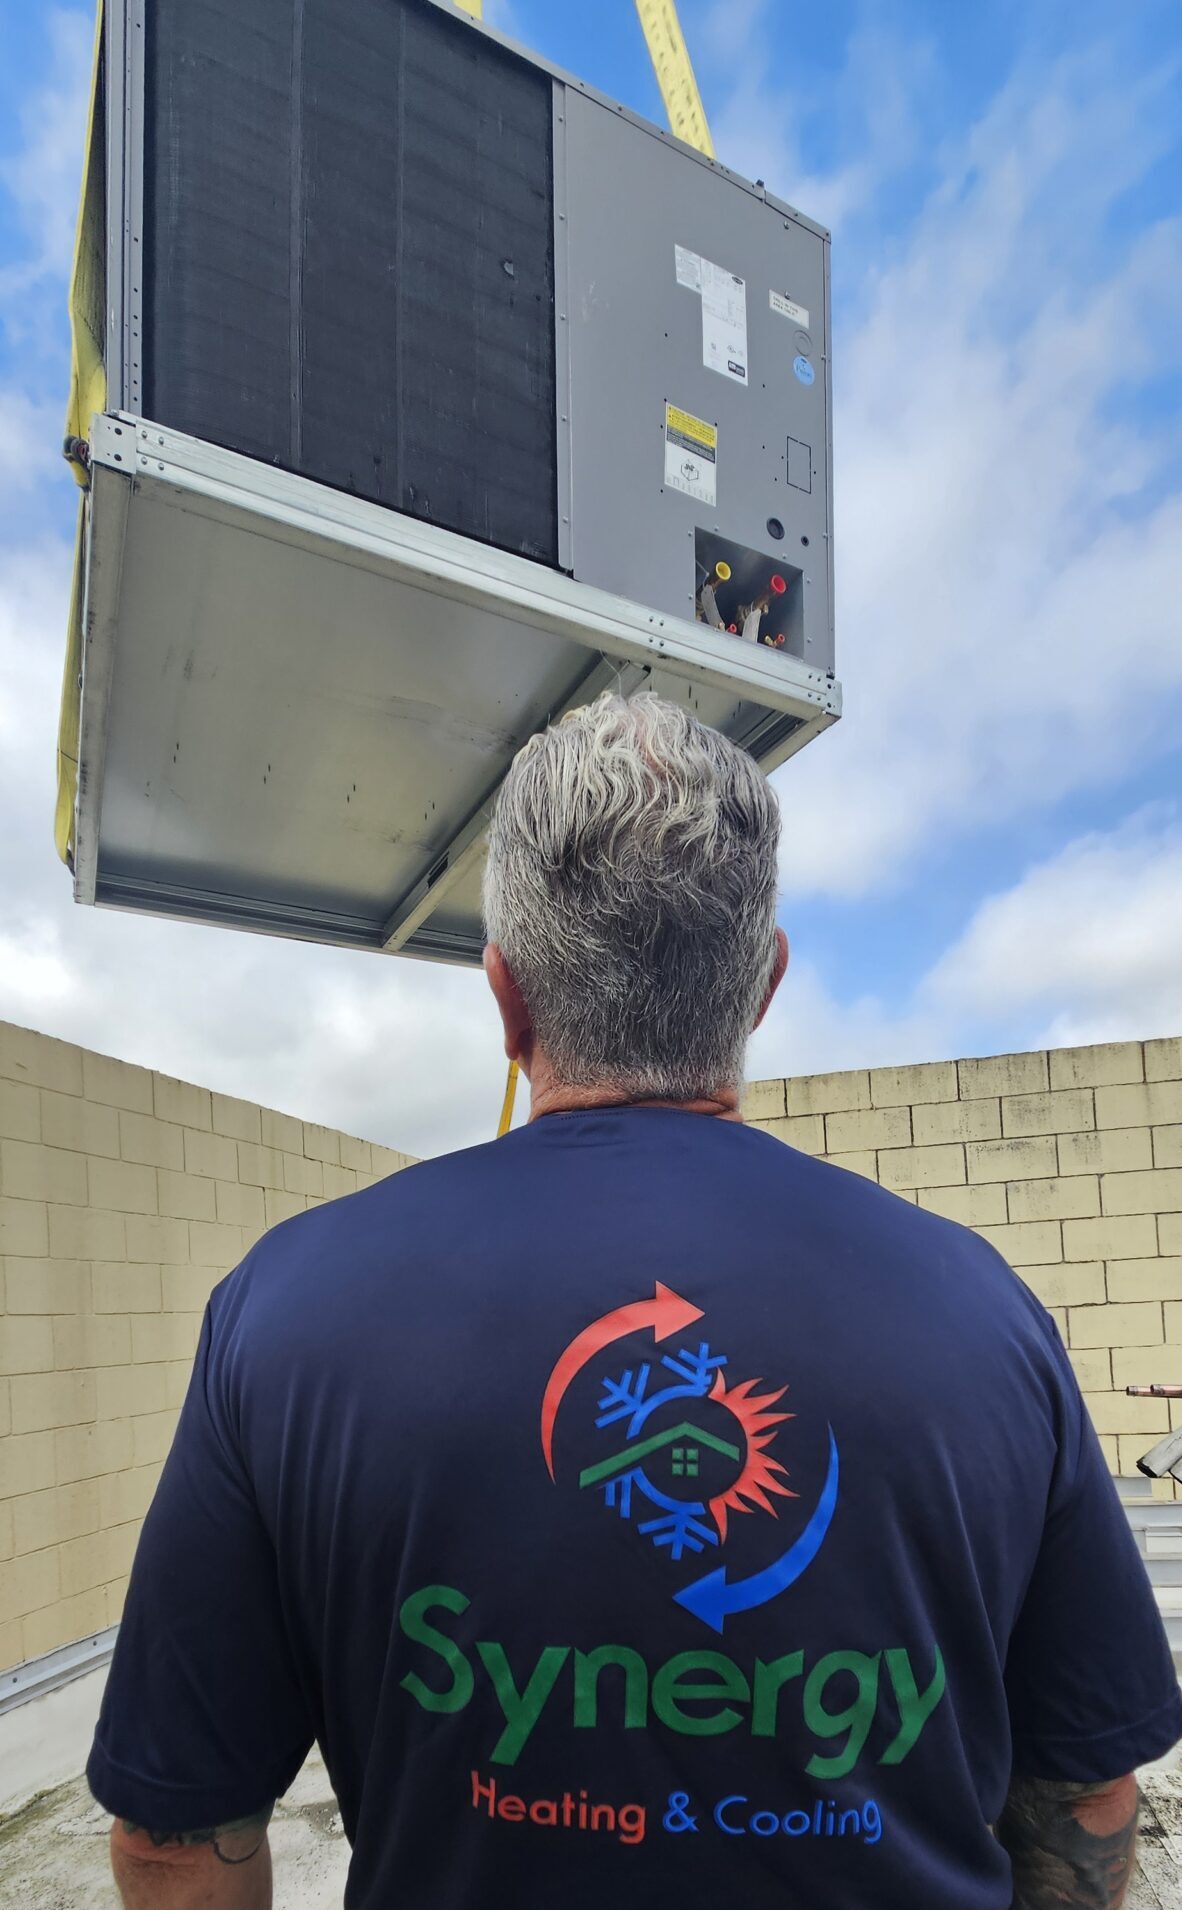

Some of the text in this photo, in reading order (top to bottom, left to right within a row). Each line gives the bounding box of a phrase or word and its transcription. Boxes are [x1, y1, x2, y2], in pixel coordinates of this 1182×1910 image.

[400, 1585, 946, 1779] Synergy
[471, 1770, 884, 1844] Heating & Cooling
